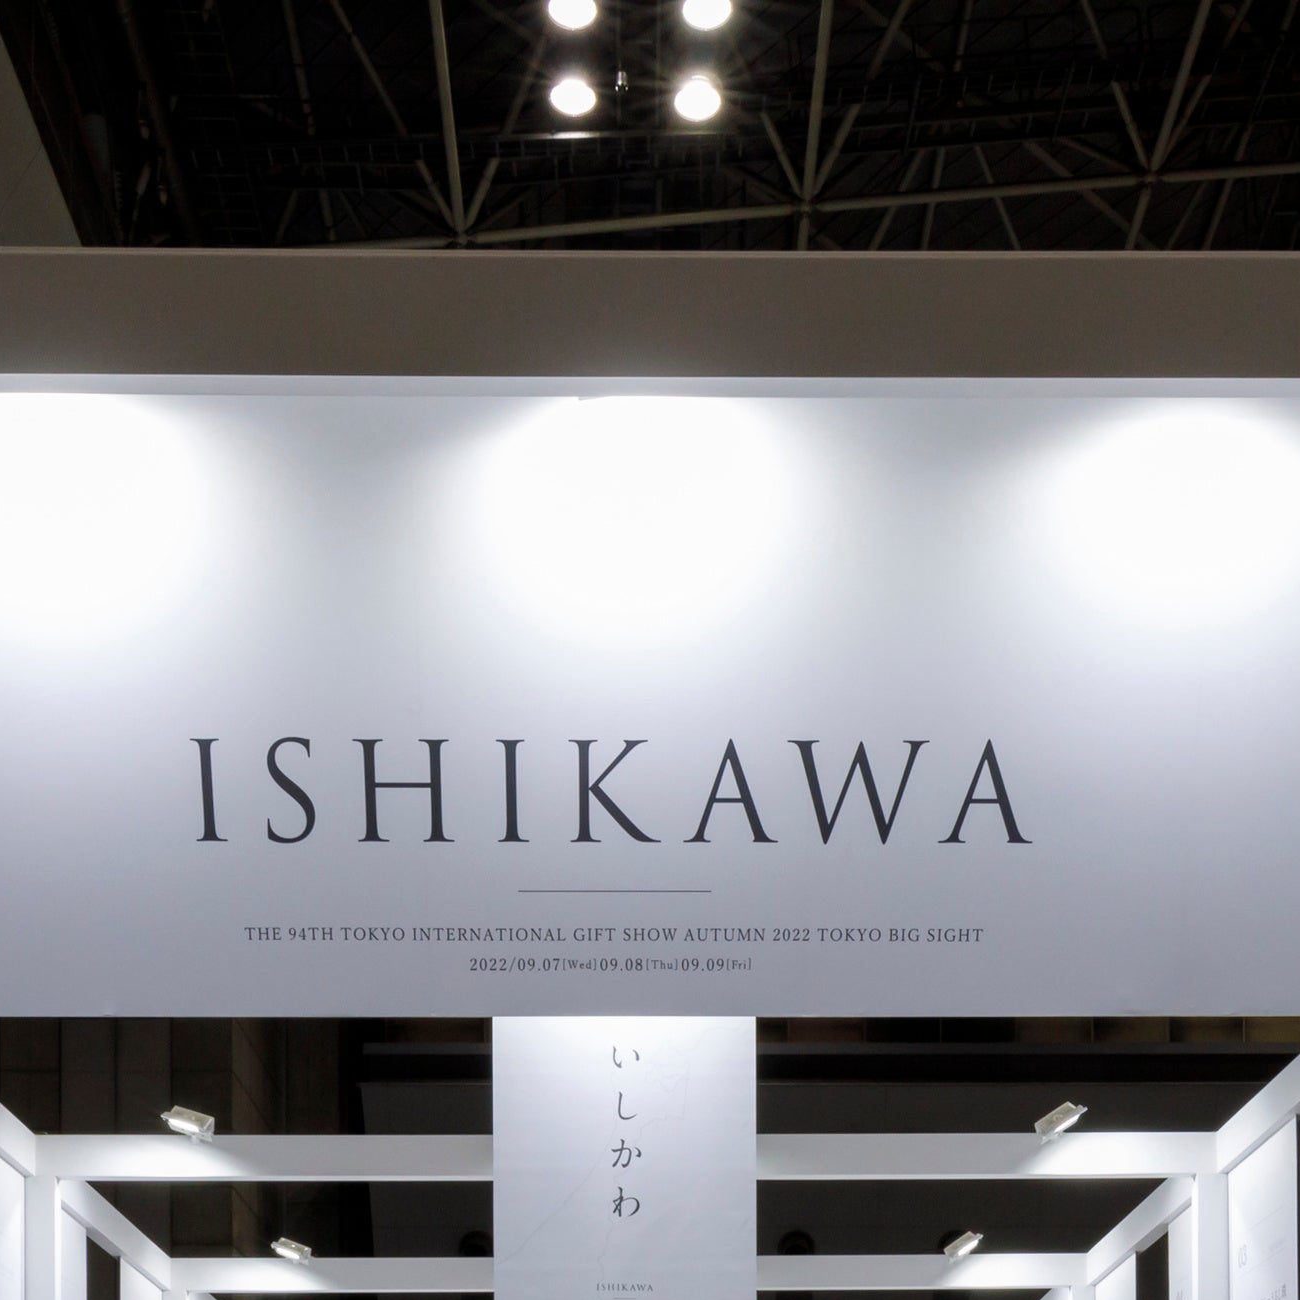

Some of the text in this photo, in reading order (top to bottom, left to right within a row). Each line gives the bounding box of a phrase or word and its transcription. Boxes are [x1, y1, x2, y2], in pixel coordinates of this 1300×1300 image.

[190, 737, 1033, 845] ISHIKAWA
[244, 927, 983, 942] THE 94TH TOKYO INTERNATIONAL GIFT SHOW AUTUMN 2022 TOKYO BIG SIGHT
[611, 1045, 642, 1218] いしかわ
[596, 1282, 654, 1292] ISHIKAWA
